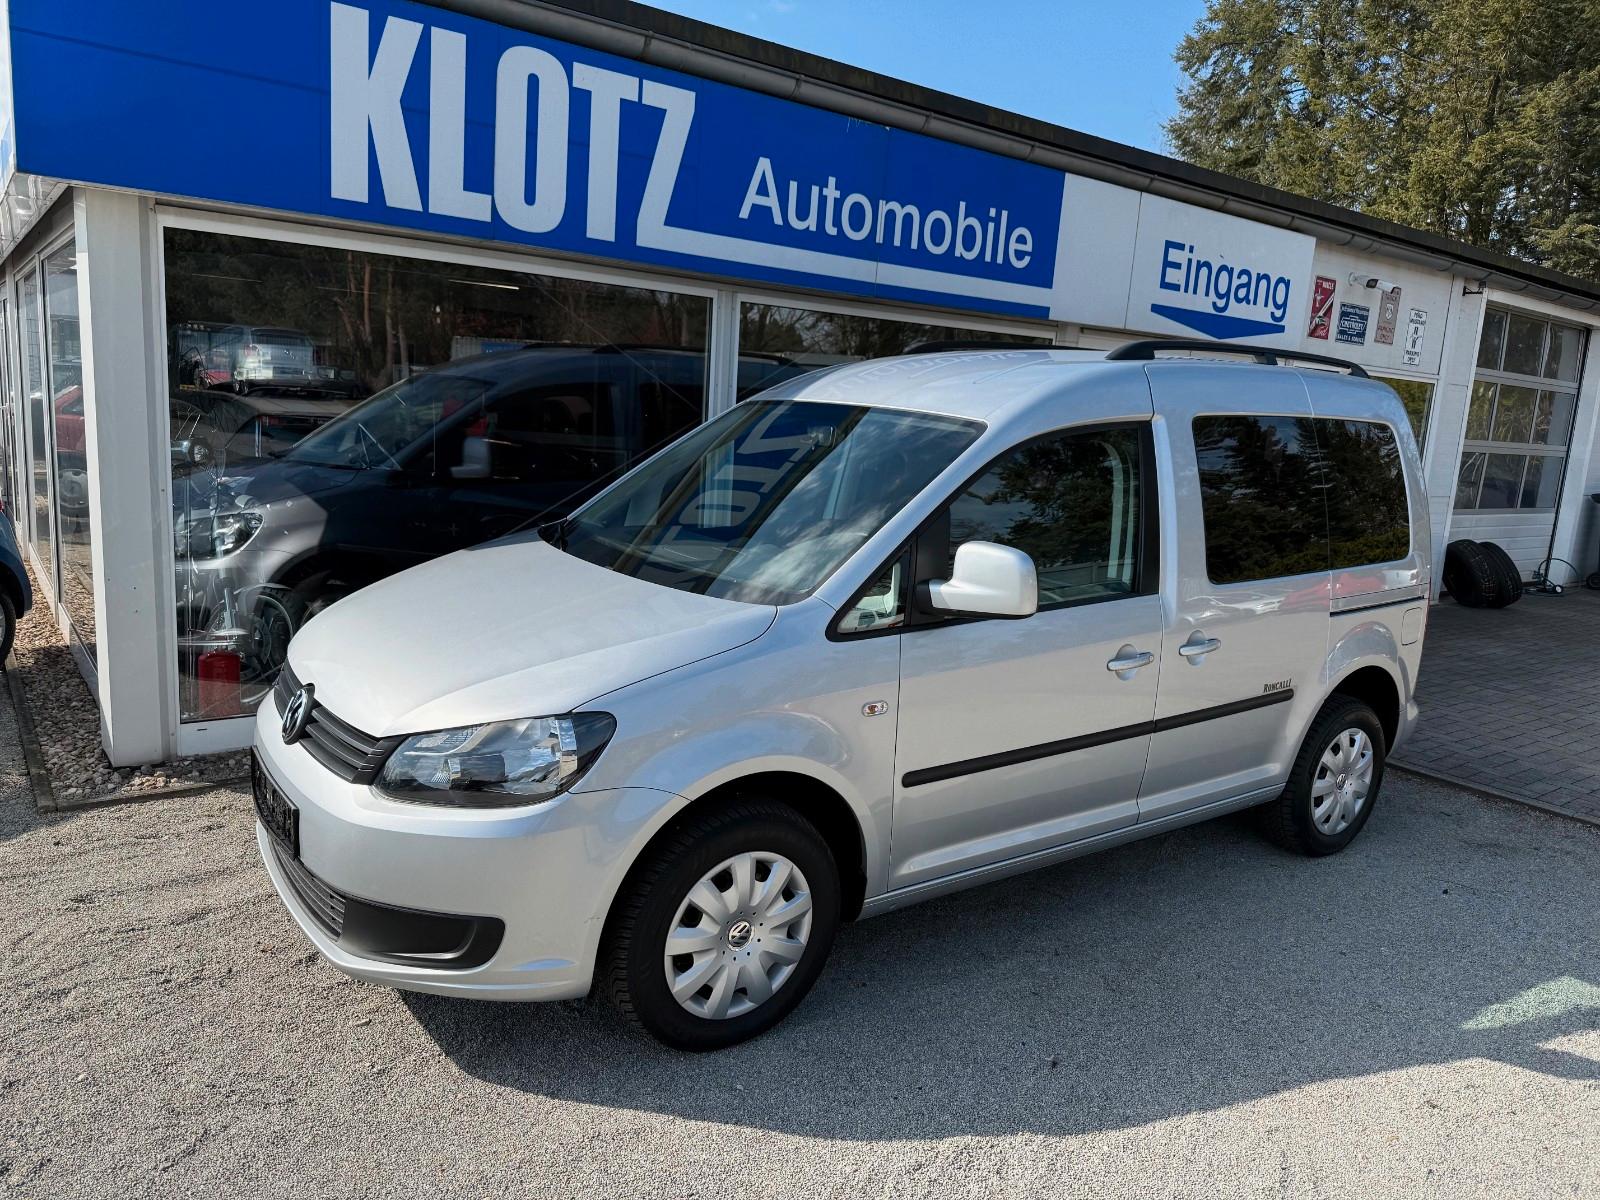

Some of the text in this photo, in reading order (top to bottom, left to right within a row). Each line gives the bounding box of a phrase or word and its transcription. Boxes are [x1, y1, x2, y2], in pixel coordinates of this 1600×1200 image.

[331, 1, 696, 247] KLOTZ
[738, 156, 1034, 269] Automobile
[1159, 239, 1291, 323] Eingang
